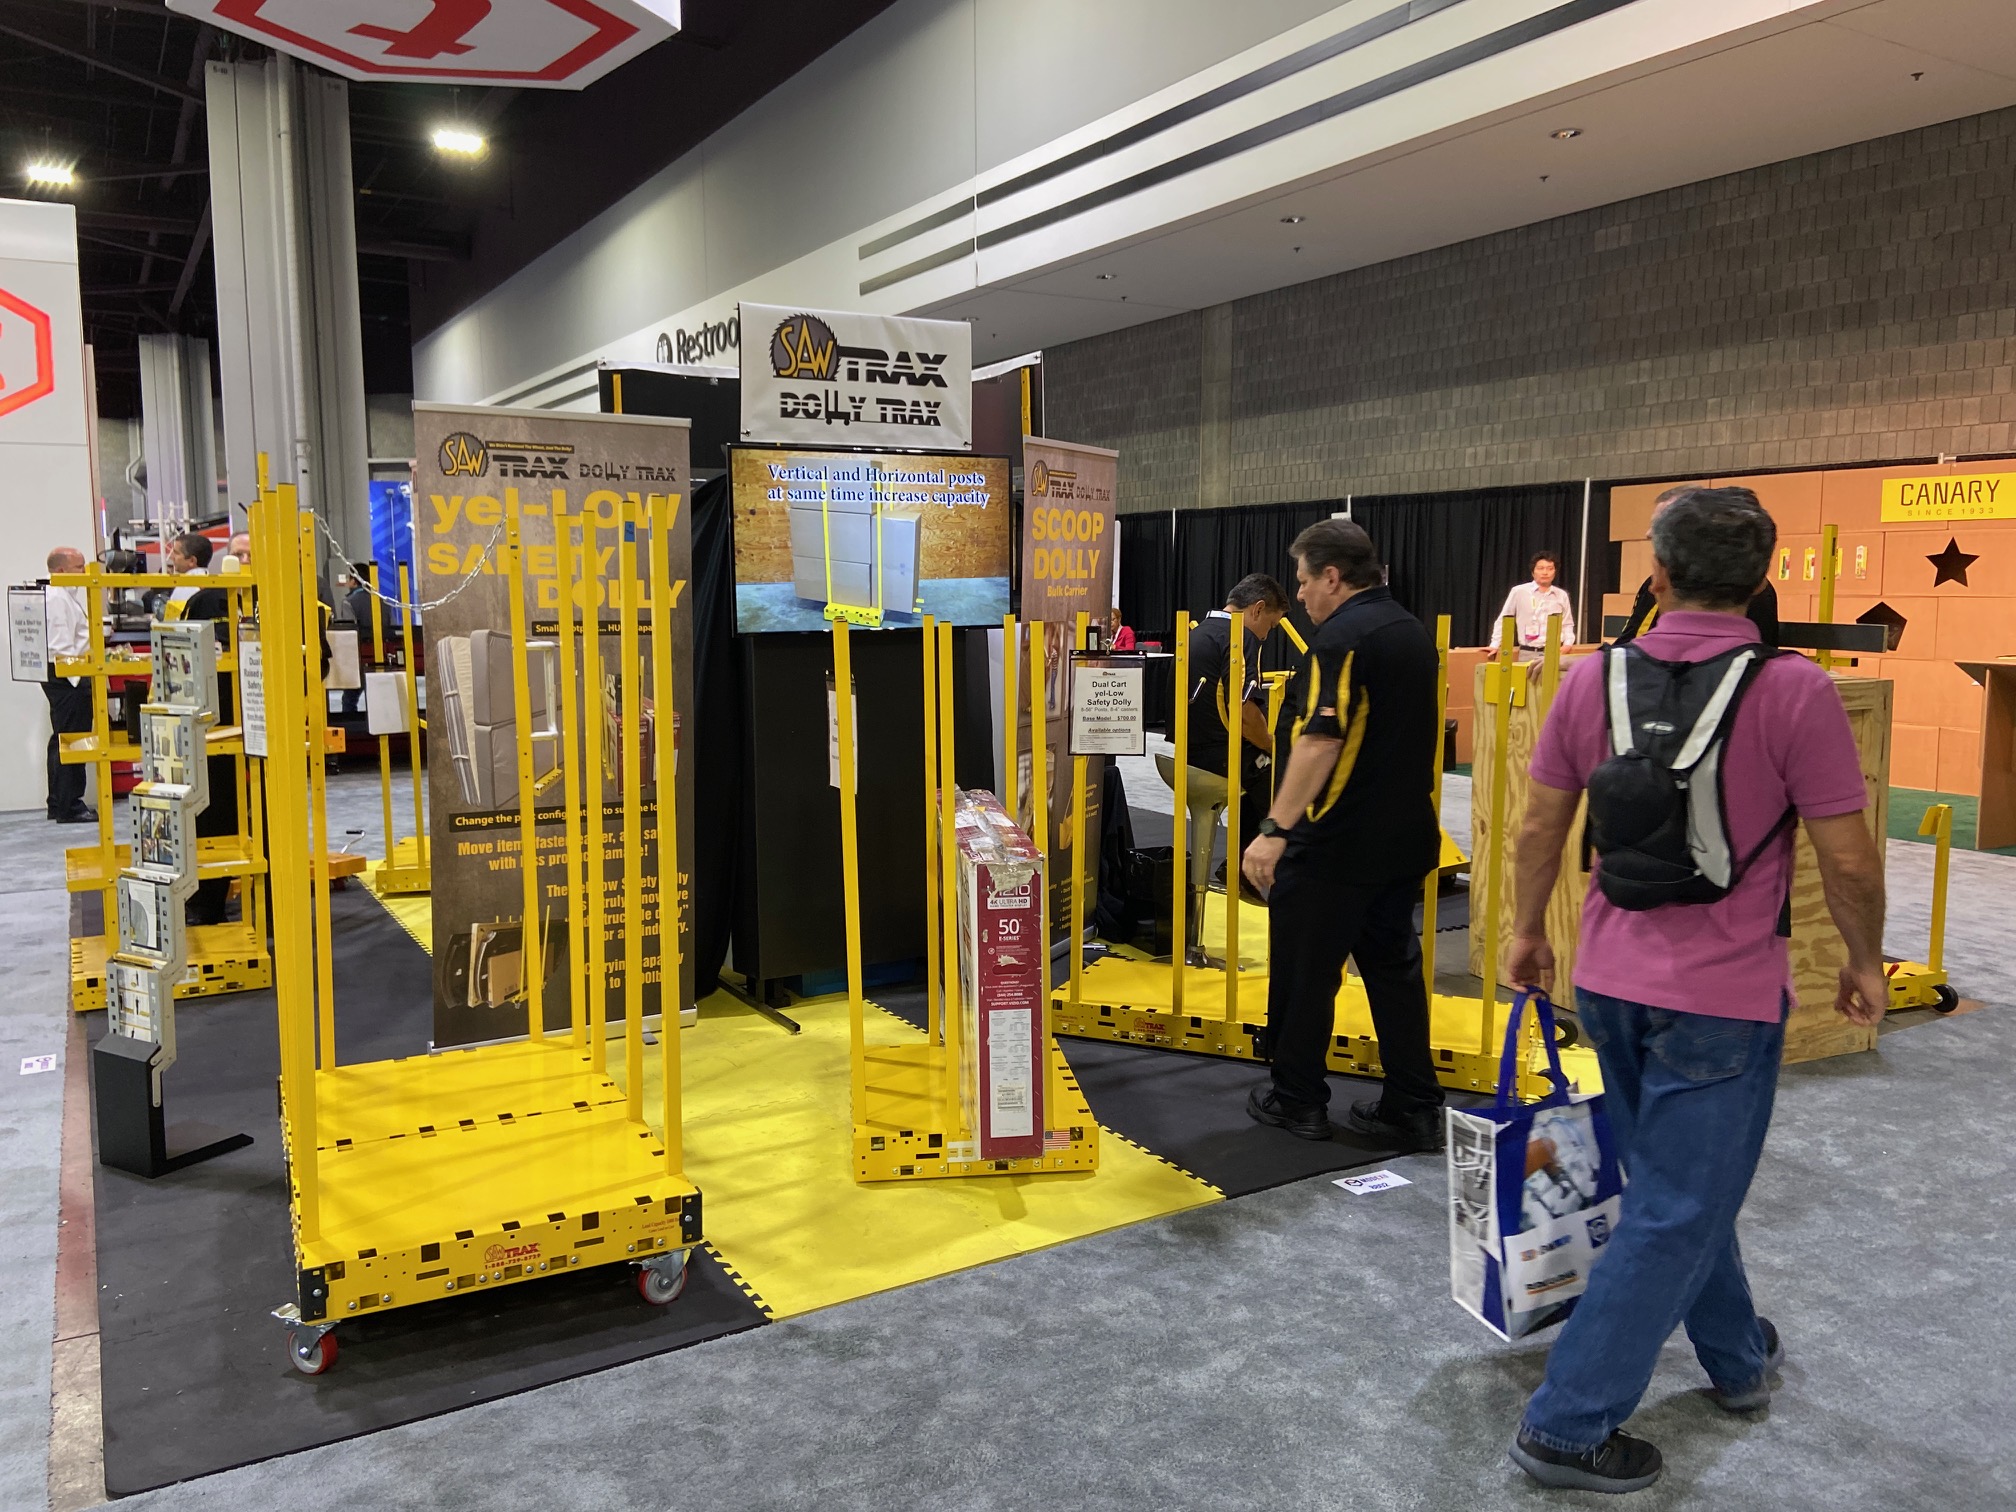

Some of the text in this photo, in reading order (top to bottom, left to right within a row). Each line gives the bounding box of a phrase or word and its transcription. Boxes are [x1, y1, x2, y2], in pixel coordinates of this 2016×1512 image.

[676, 317, 739, 364] Restroo
[779, 319, 948, 387] SAW TRAX
[780, 389, 942, 426] DOLLY TRAX
[445, 435, 569, 480] SAW TRAX
[636, 466, 676, 481] TRAX
[767, 464, 985, 488] Vertical and Horizontal posts
[1033, 463, 1074, 500] SAW TRAX
[767, 489, 989, 508] at same time increase capacity
[1901, 480, 2000, 506] CANARY
[1907, 507, 1994, 517] SINCE 1933
[1032, 506, 1105, 542] SCOOP
[1034, 547, 1100, 579] DOLLY
[1047, 585, 1088, 597] Bulk Carrier
[1095, 690, 1124, 698] yel-Low
[455, 815, 494, 827] Change
[496, 814, 513, 824] the
[458, 842, 493, 856] Move
[497, 839, 523, 852] item
[489, 857, 517, 871] with
[546, 885, 567, 897] The
[505, 1242, 539, 1258] TRAX
